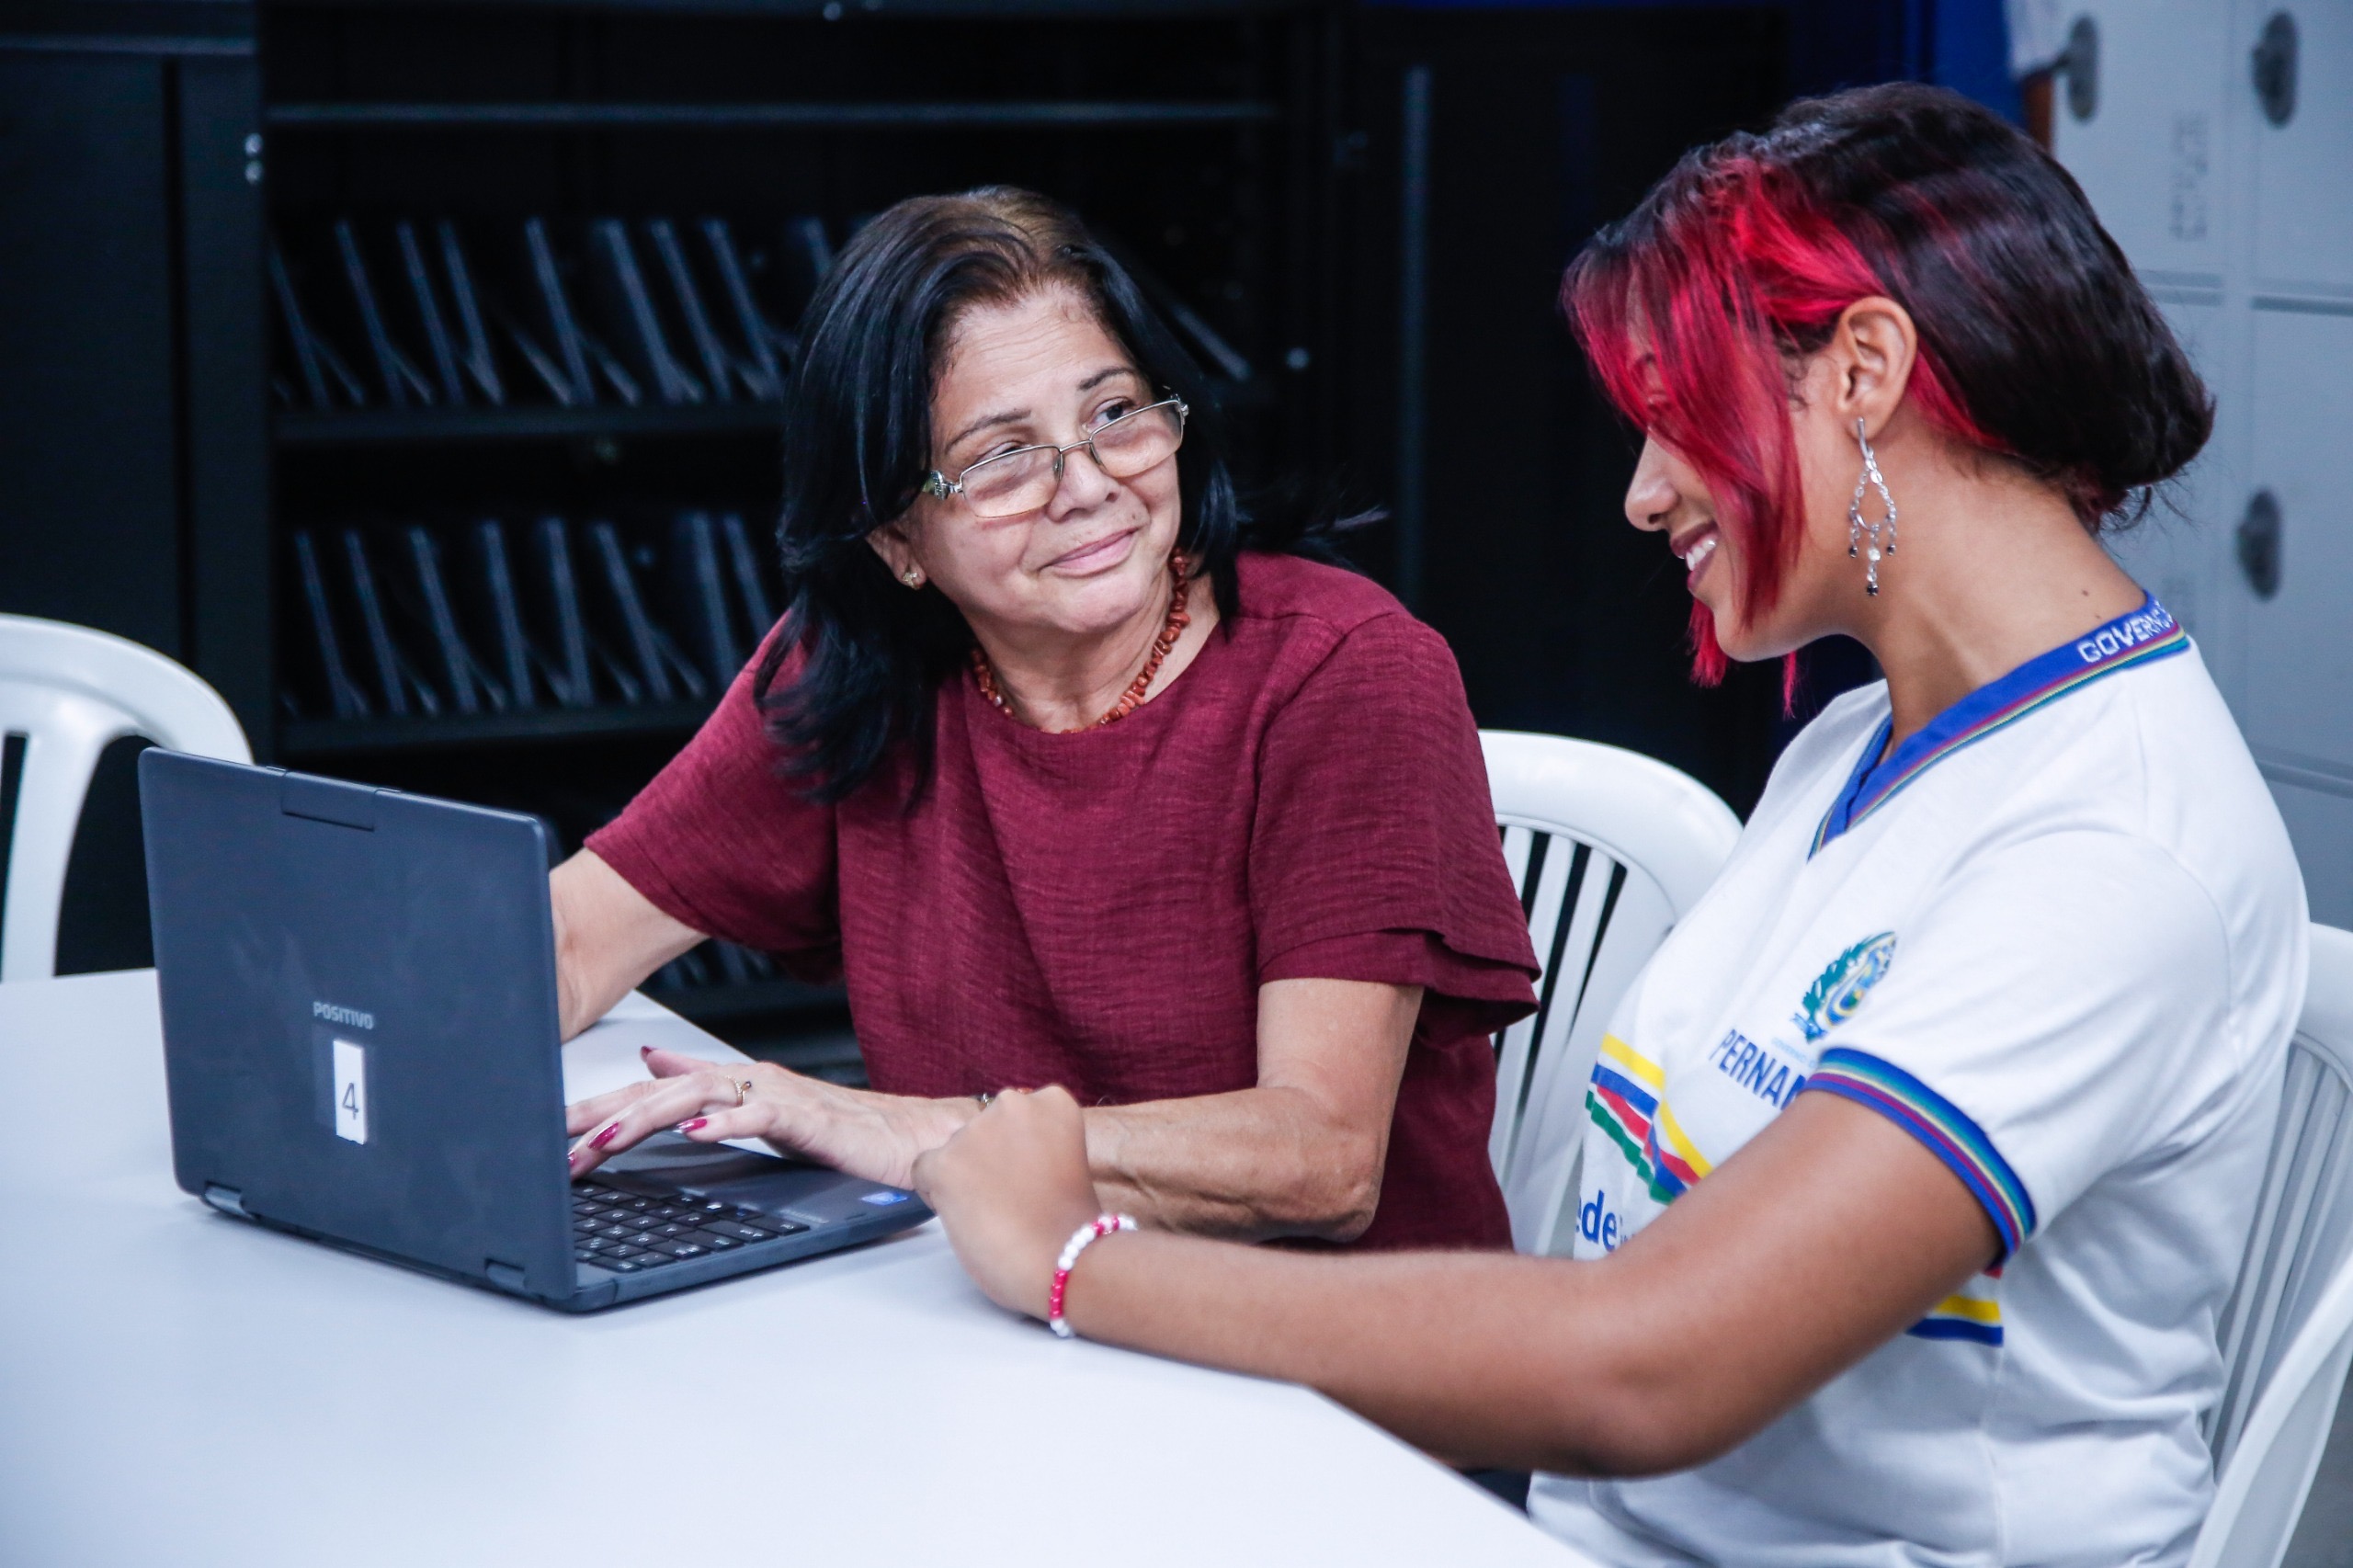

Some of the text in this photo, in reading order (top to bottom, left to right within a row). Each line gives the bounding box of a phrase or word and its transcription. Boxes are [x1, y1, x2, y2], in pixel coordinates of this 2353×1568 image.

[313, 1001, 374, 1029] POSITIVO
[342, 1082, 358, 1120] 4
[1576, 1189, 1618, 1253] de
